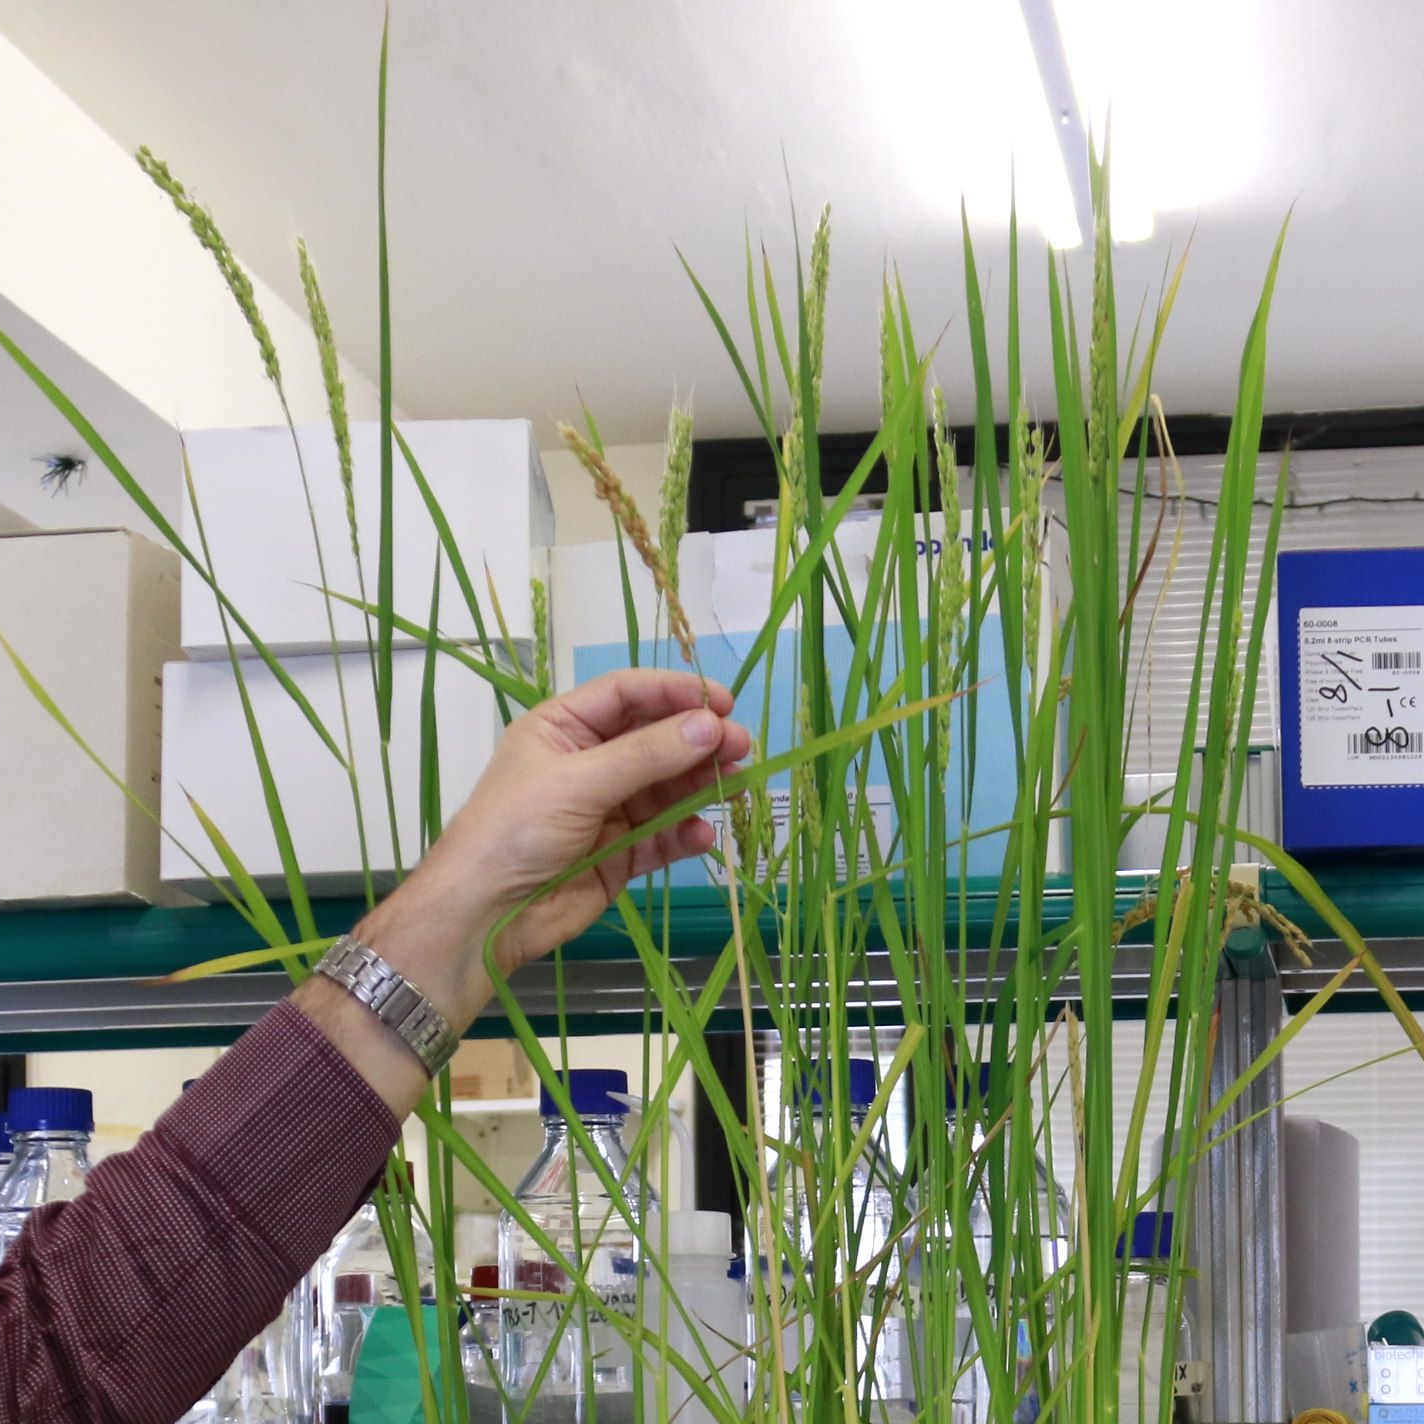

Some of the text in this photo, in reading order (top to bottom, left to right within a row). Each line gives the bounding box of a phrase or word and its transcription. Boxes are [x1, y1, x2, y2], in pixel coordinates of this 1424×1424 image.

[1303, 620, 1338, 628] 60-0008
[1327, 636, 1353, 645] 8-strip
[1354, 635, 1372, 643] PCR
[1374, 635, 1397, 643] Tubes
